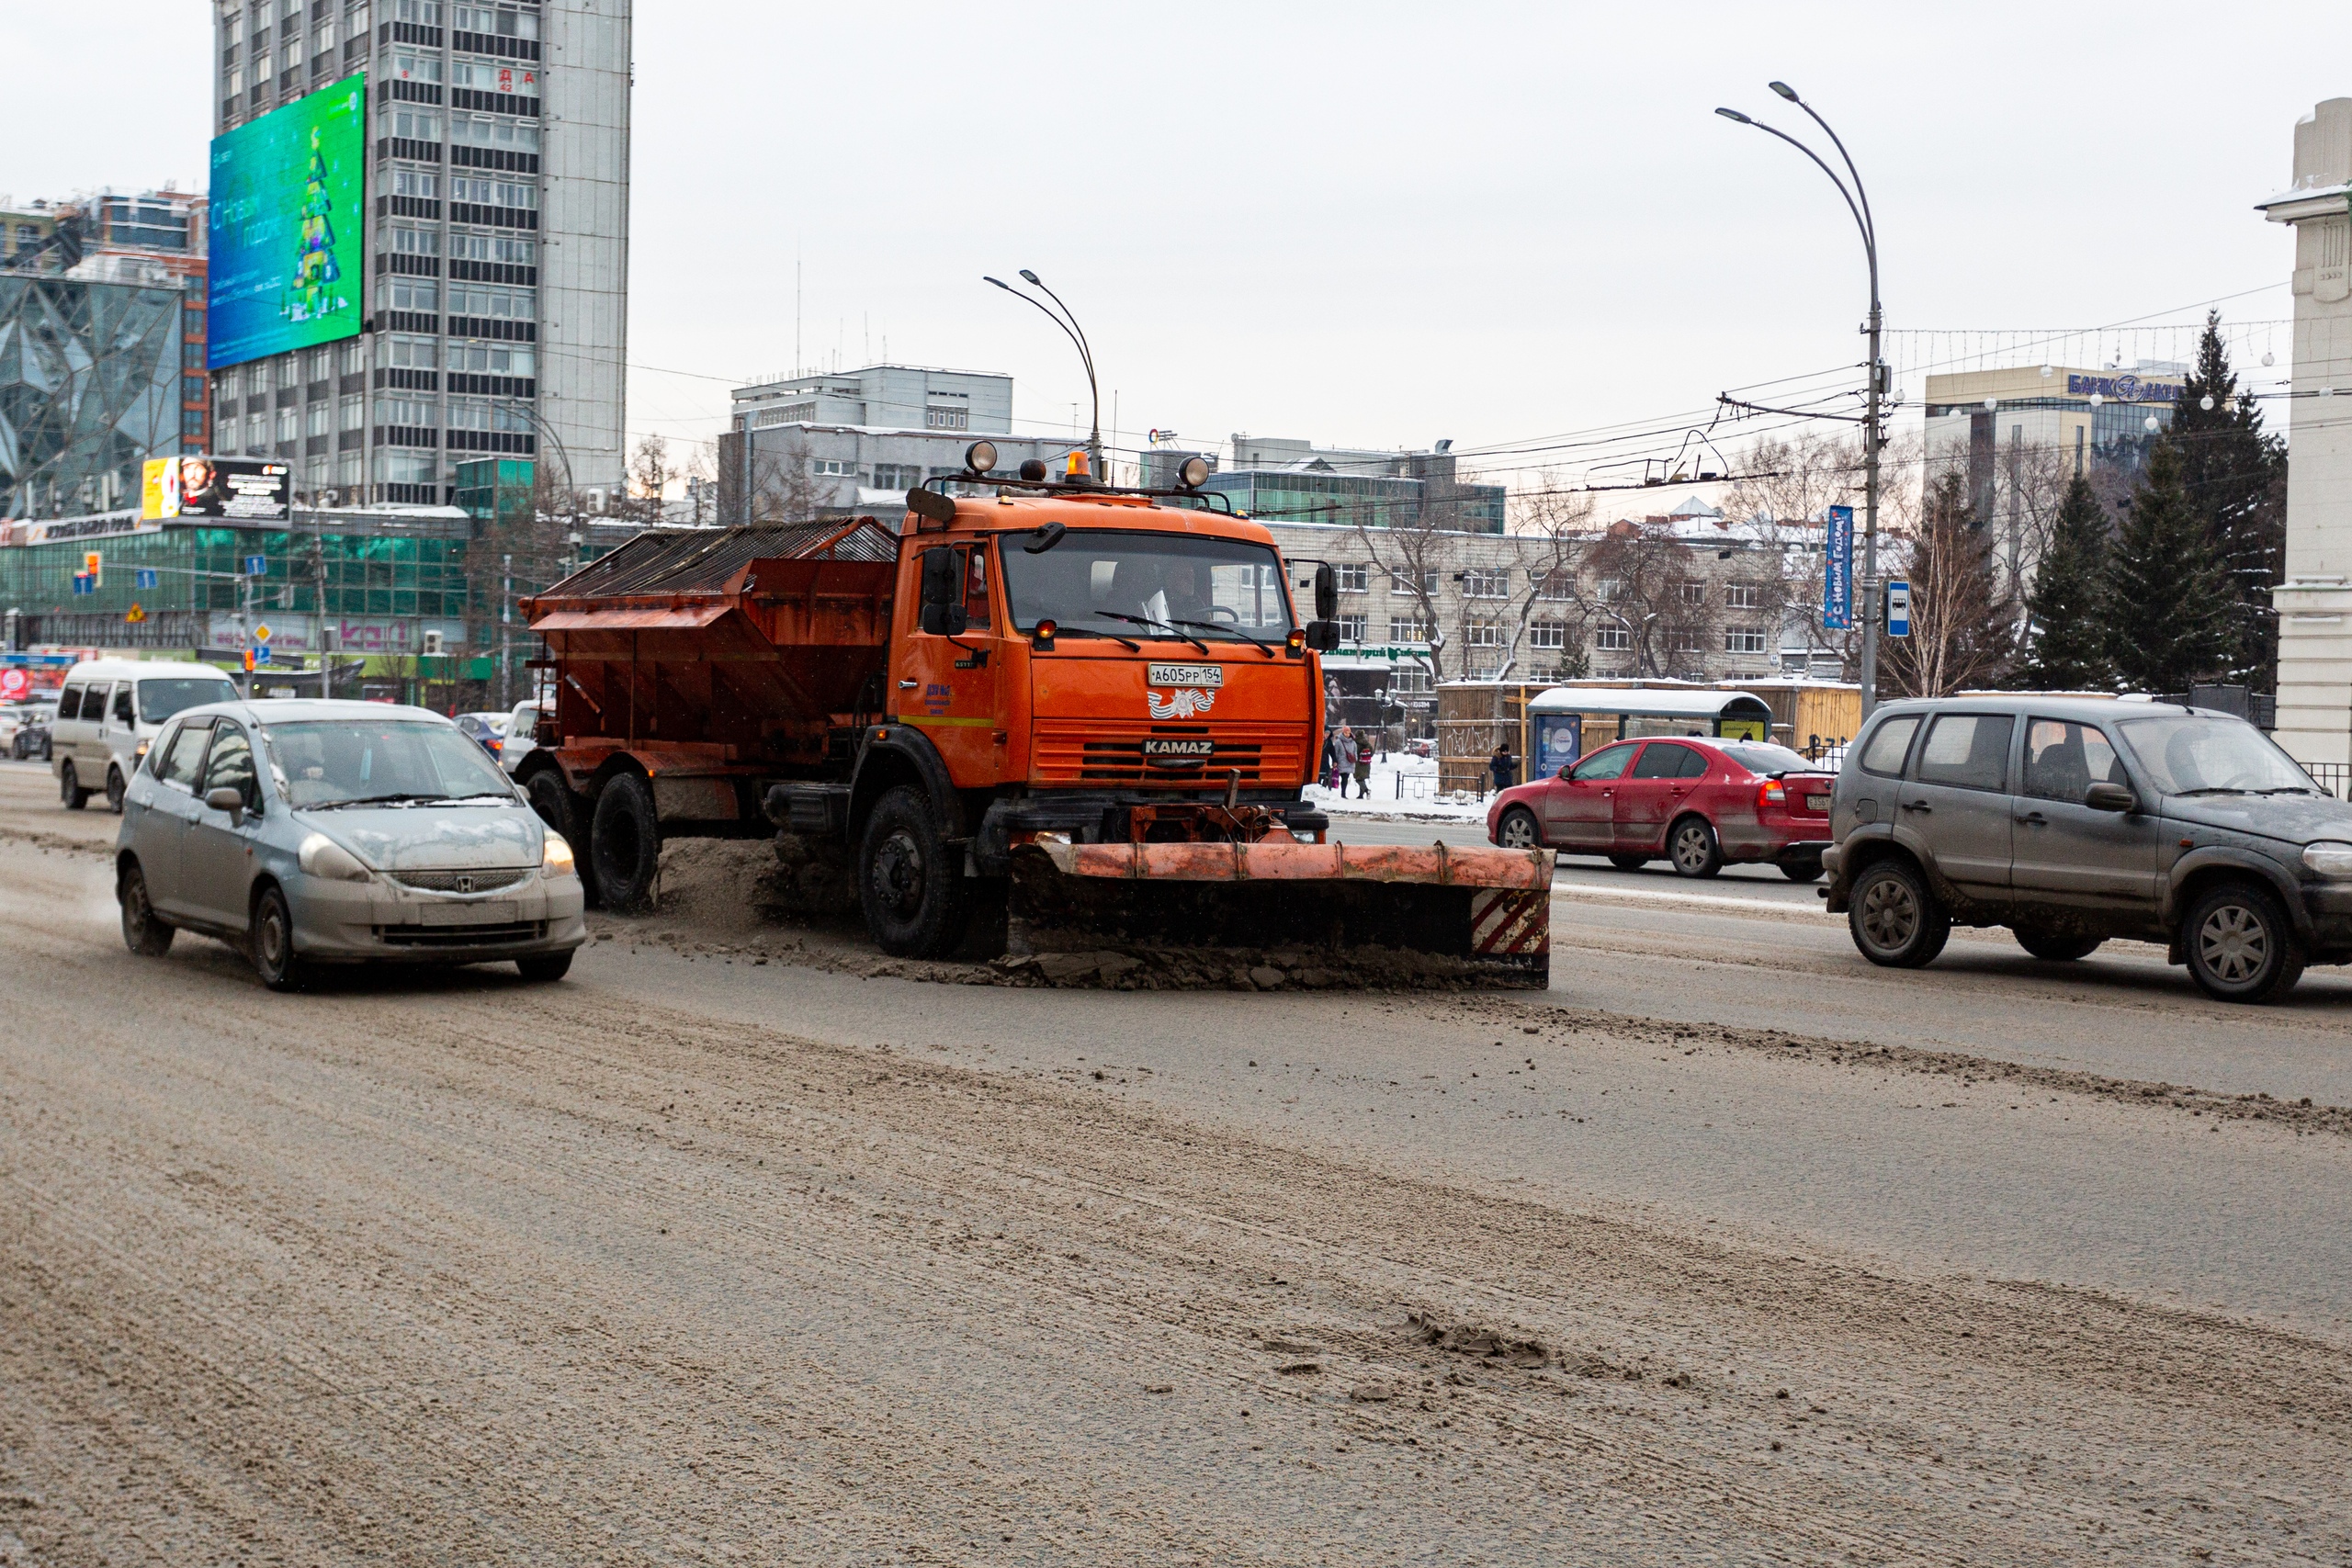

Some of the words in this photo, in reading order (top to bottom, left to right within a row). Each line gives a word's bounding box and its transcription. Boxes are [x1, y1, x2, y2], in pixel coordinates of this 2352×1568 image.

[2069, 374, 2116, 397] БАНК
[1832, 605, 1843, 615] С
[1155, 668, 1200, 682] А605РР
[1202, 669, 1220, 679] 154
[1145, 740, 1212, 753] KAMAZ
